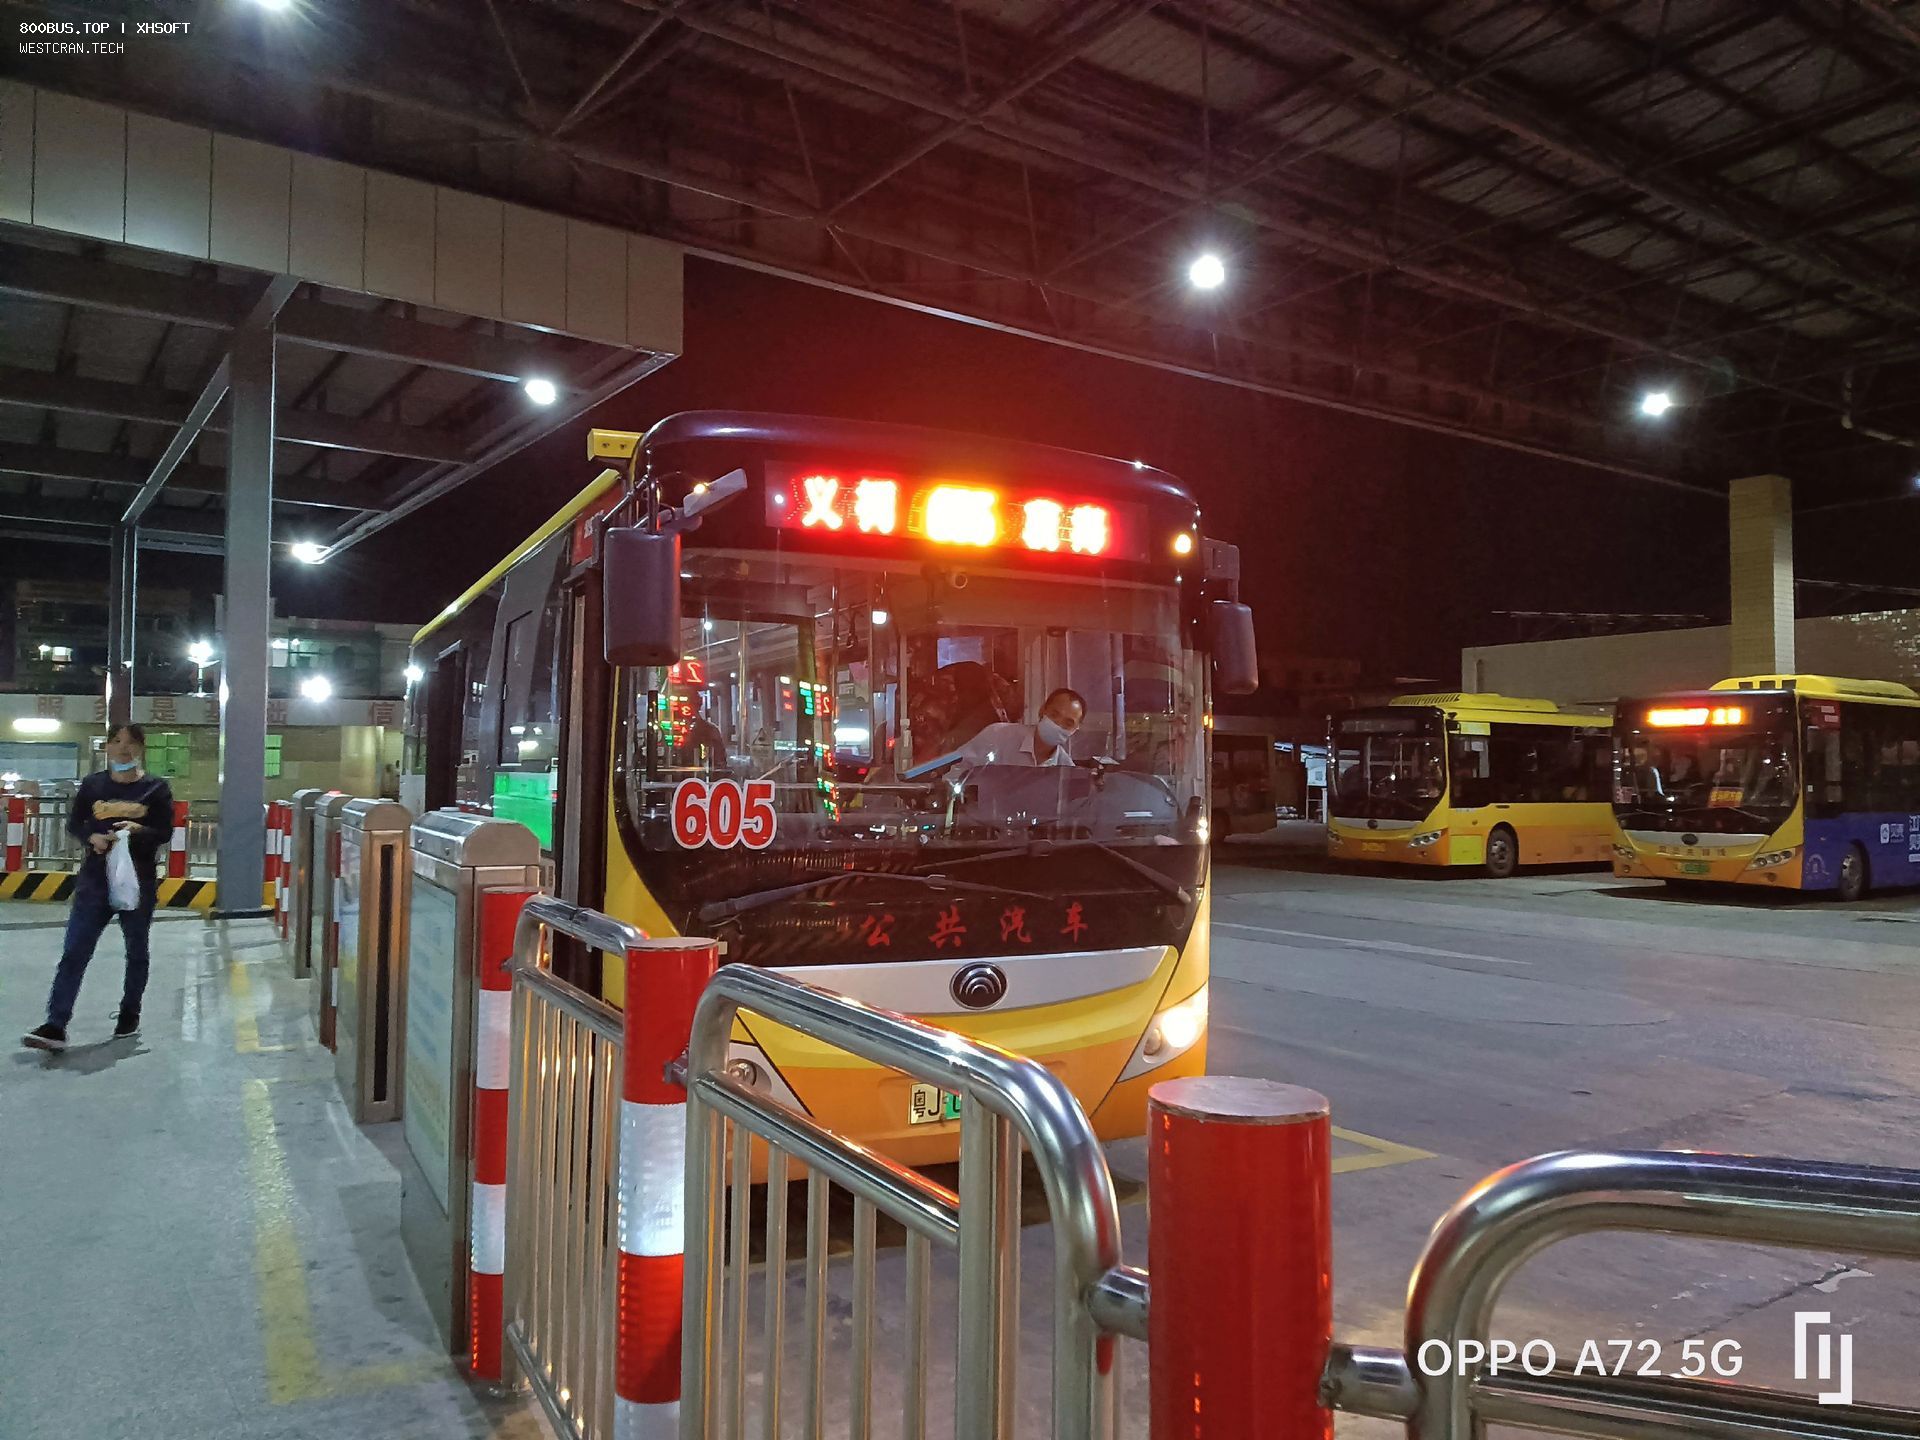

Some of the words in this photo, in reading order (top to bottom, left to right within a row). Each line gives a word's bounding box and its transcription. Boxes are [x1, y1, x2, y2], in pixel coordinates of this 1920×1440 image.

[671, 777, 777, 850] 605
[860, 902, 1089, 948] 公共汽车
